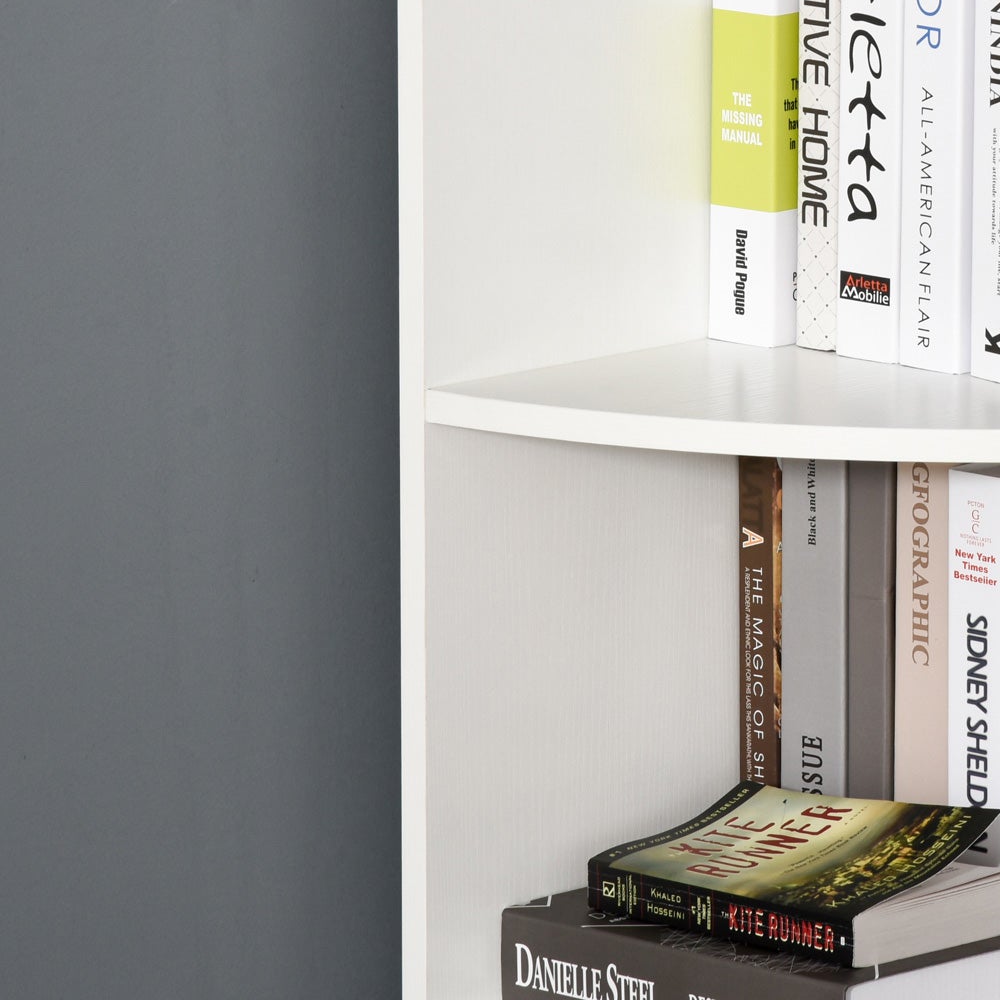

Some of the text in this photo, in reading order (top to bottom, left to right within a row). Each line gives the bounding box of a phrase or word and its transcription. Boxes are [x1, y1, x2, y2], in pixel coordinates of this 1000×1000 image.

[732, 92, 752, 107] THE
[784, 98, 798, 112] that
[722, 109, 763, 127] MISSING
[722, 128, 763, 146] MANUAL
[790, 138, 796, 150] in
[801, 106, 830, 228] HOME
[916, 86, 934, 349] ALL-AMERICAN FLAIR
[734, 228, 748, 316] David Pogue
[846, 274, 888, 293] Arletta
[842, 284, 889, 306] Mobilie
[808, 492, 816, 512] and
[808, 516, 816, 546] Black
[954, 548, 974, 559] New
[962, 560, 989, 573] Times
[751, 567, 765, 785] THE MAGIC OF SH
[966, 613, 988, 714] SIDNEY
[626, 842, 646, 851] NEW
[649, 835, 671, 844] YORK
[674, 823, 700, 836] TIMES
[700, 788, 750, 825] BESTSELLER
[668, 816, 776, 856] KITE
[686, 805, 853, 878] RUNNER
[826, 875, 898, 908] KHALED
[897, 815, 972, 876] HOSSEINI
[650, 888, 682, 904] KHALED
[647, 902, 685, 920] HOSSEINI
[728, 904, 765, 935] KITE
[769, 912, 834, 953] RUNNER
[514, 943, 603, 1000] DANIELLE
